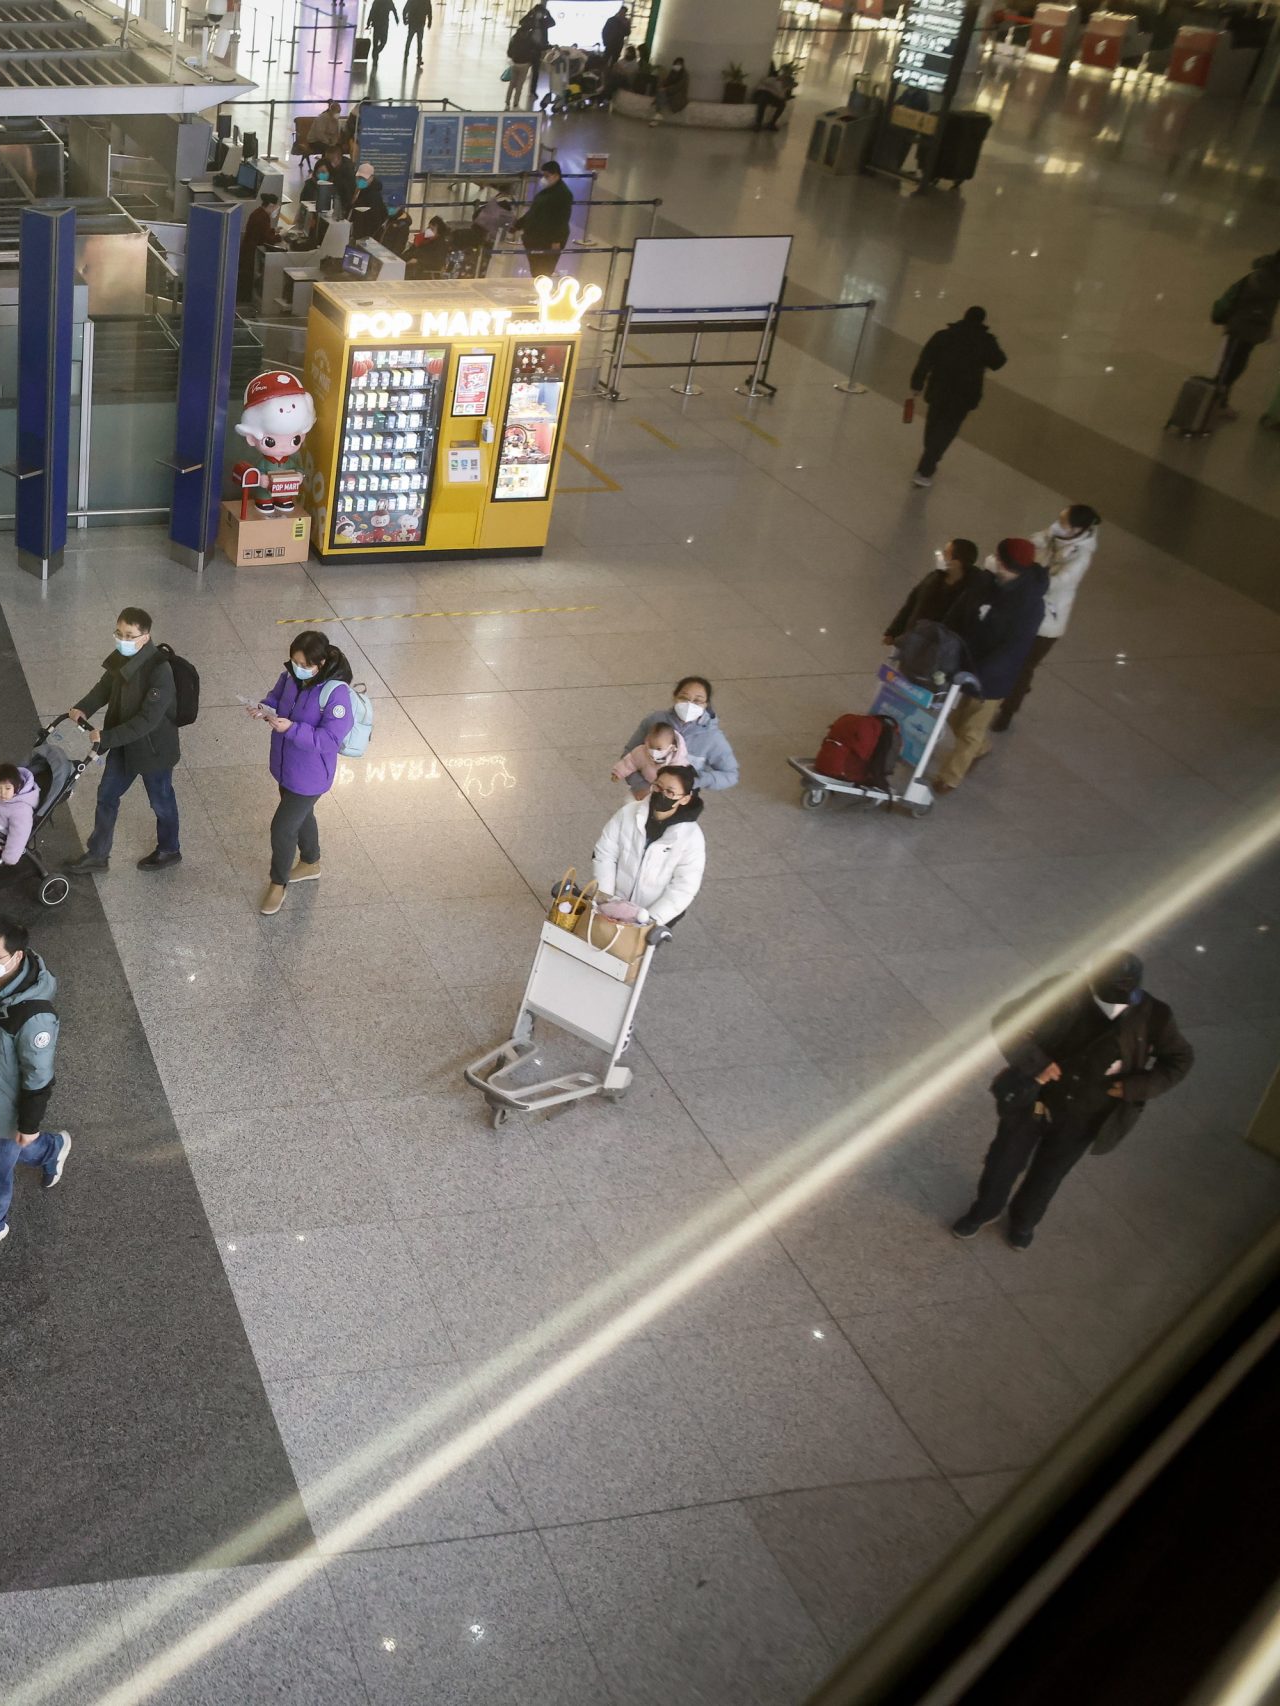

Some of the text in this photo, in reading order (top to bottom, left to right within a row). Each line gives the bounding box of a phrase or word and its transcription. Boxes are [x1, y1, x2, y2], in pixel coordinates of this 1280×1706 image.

[349, 310, 413, 338] POP
[421, 308, 511, 337] MART
[284, 483, 299, 491] MART
